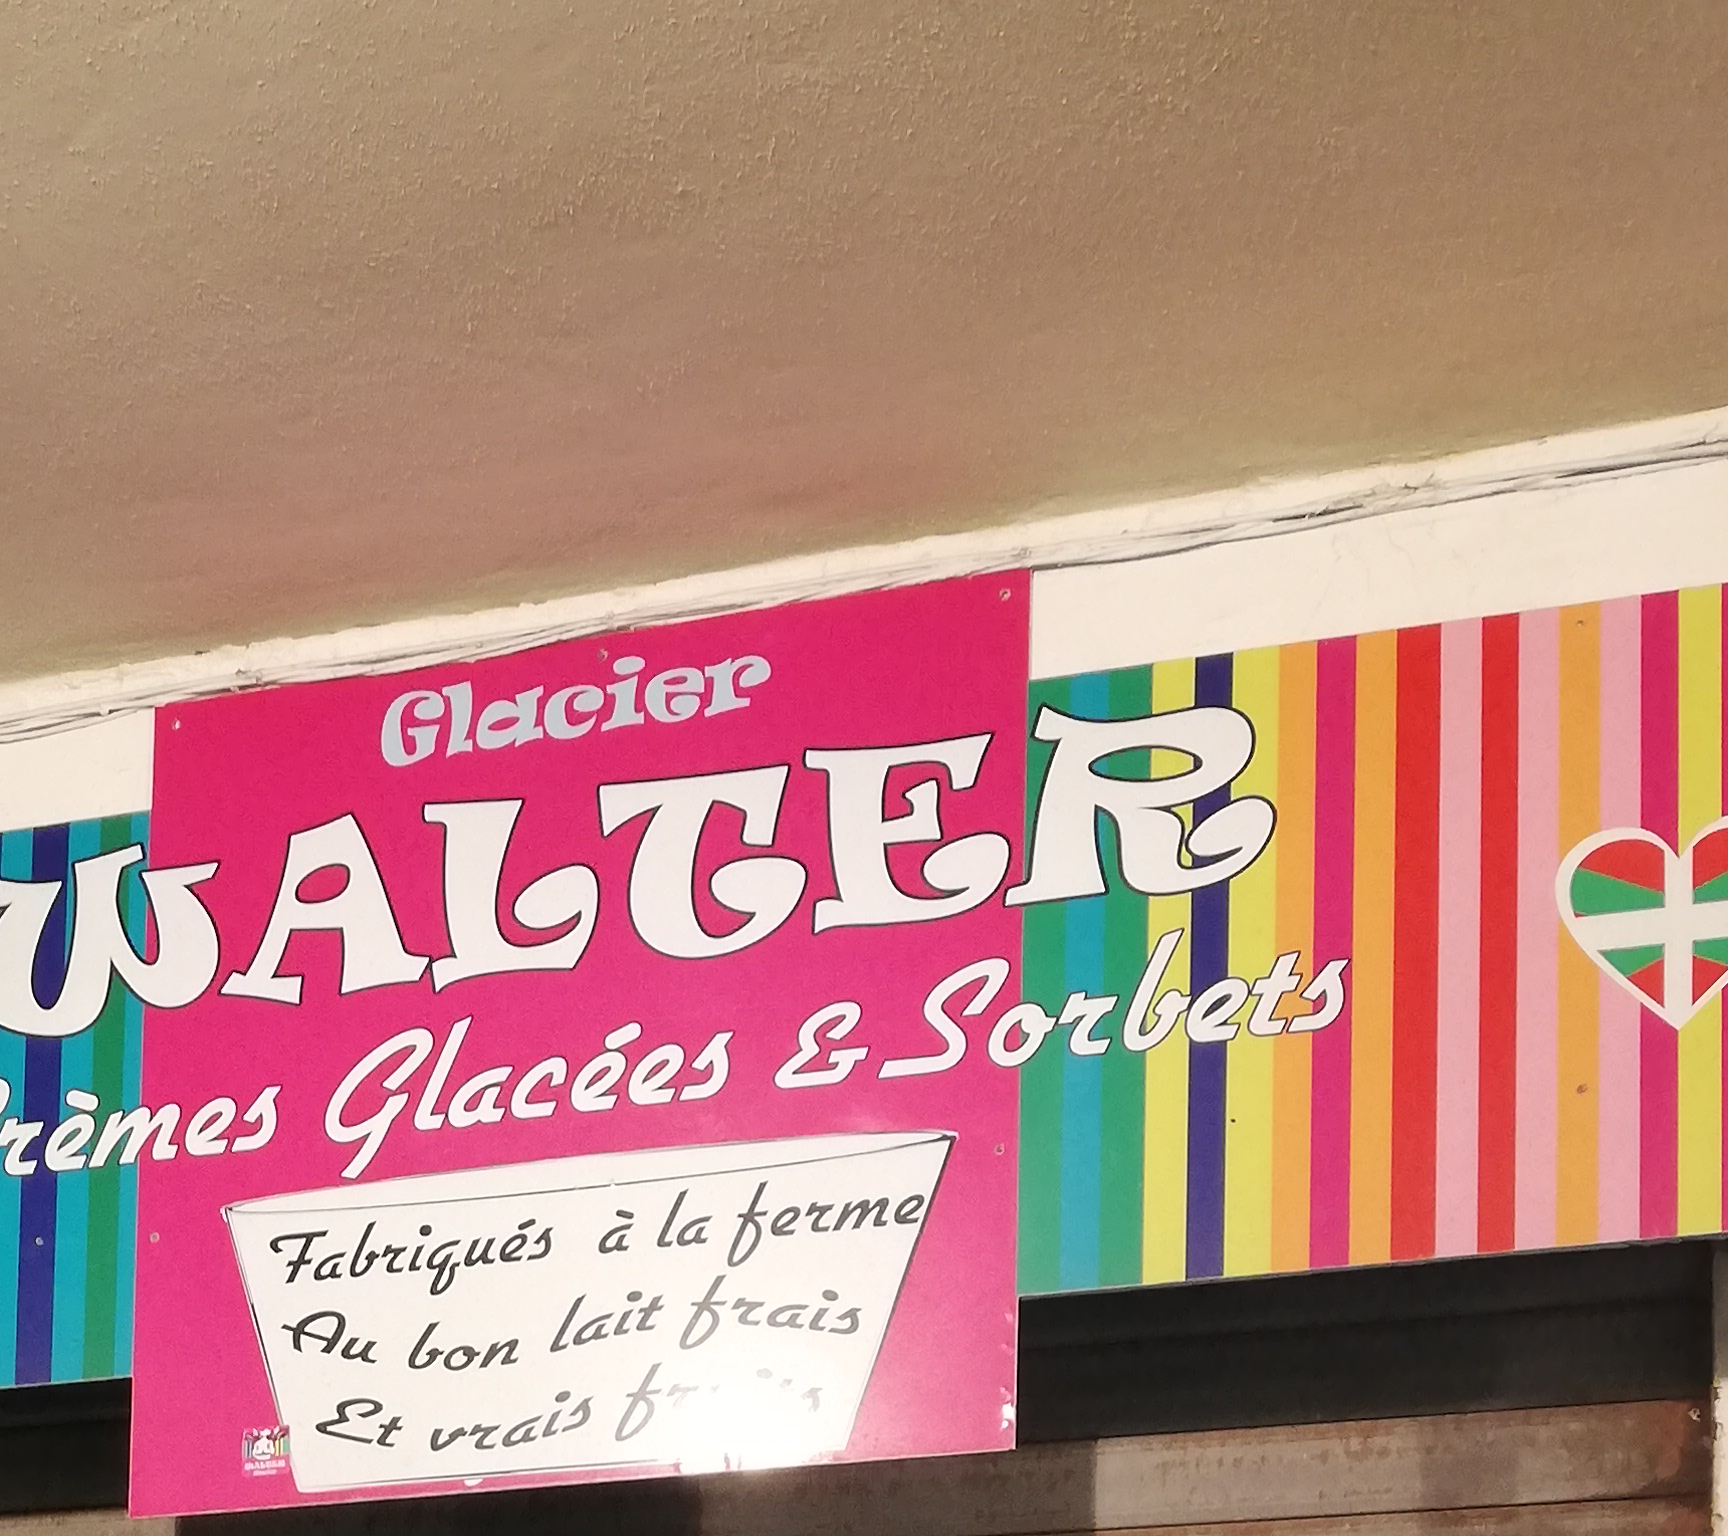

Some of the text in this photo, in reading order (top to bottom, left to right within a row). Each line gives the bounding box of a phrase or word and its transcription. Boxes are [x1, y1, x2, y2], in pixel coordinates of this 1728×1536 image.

[381, 654, 772, 768] Glacier
[324, 1022, 734, 1182] Glacées
[774, 1000, 868, 1091] &
[878, 929, 1352, 1081] Sorbets
[270, 1182, 924, 1300] Fabriqués à la ferme
[282, 1272, 864, 1375] Au bon lait frais
[316, 1397, 403, 1450] Et
[427, 1387, 594, 1455] vrais
